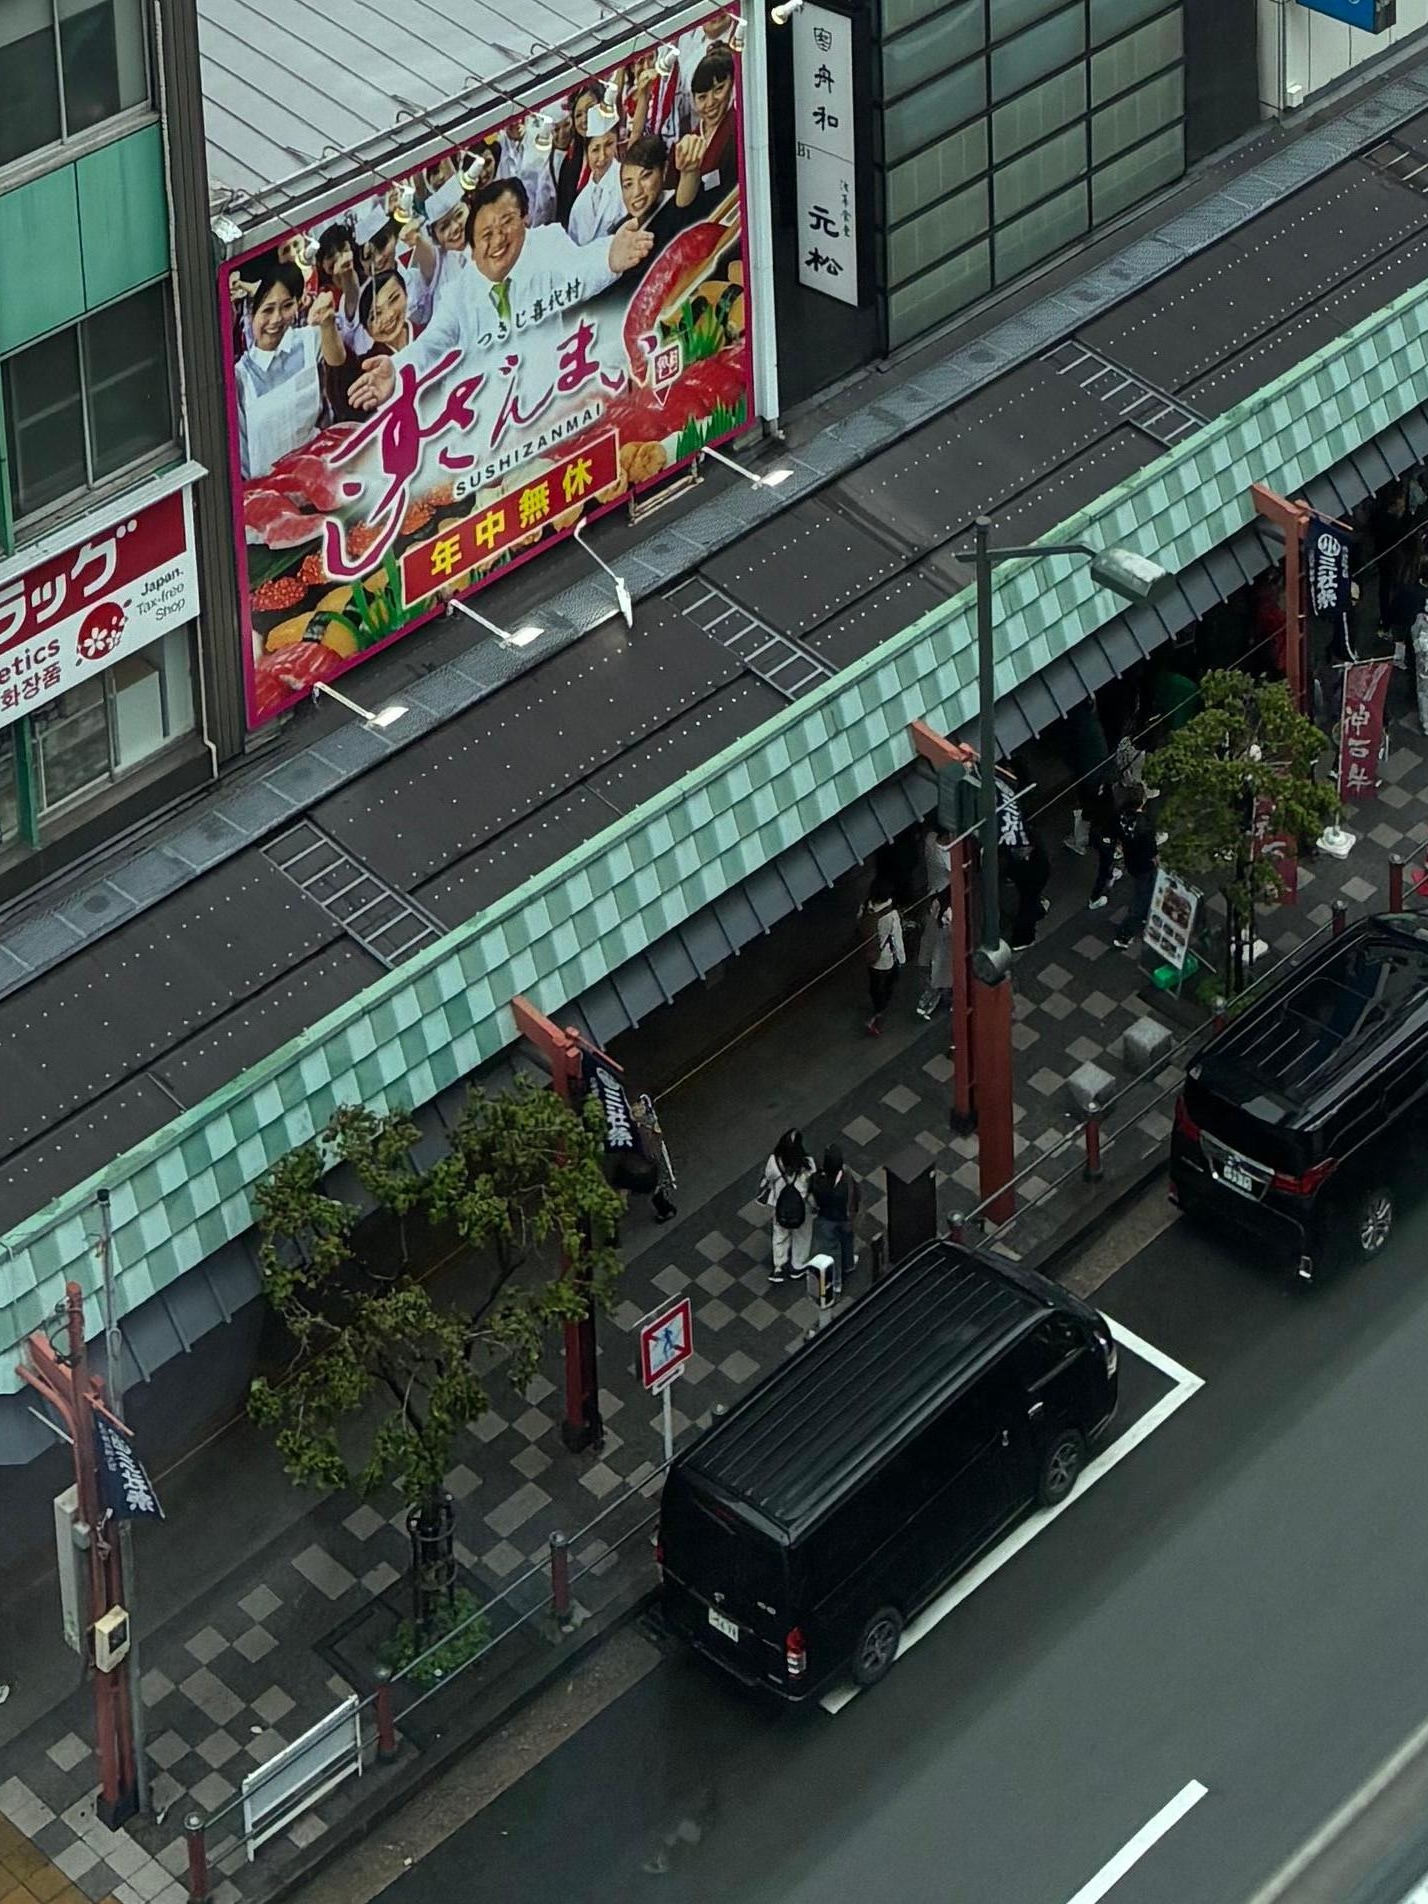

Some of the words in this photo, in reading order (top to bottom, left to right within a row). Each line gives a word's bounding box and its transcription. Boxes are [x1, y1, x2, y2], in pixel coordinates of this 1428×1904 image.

[813, 63, 839, 132] 舟和
[804, 204, 845, 277] 元松
[476, 278, 584, 349] つきじ喜代村
[324, 318, 659, 579] すしざんまい
[455, 401, 603, 498] SUSHIZANMAI
[429, 458, 594, 578] 年中無休
[154, 596, 187, 624] Shop
[1316, 555, 1339, 610] 三社祭
[0, 658, 64, 712] 화장품
